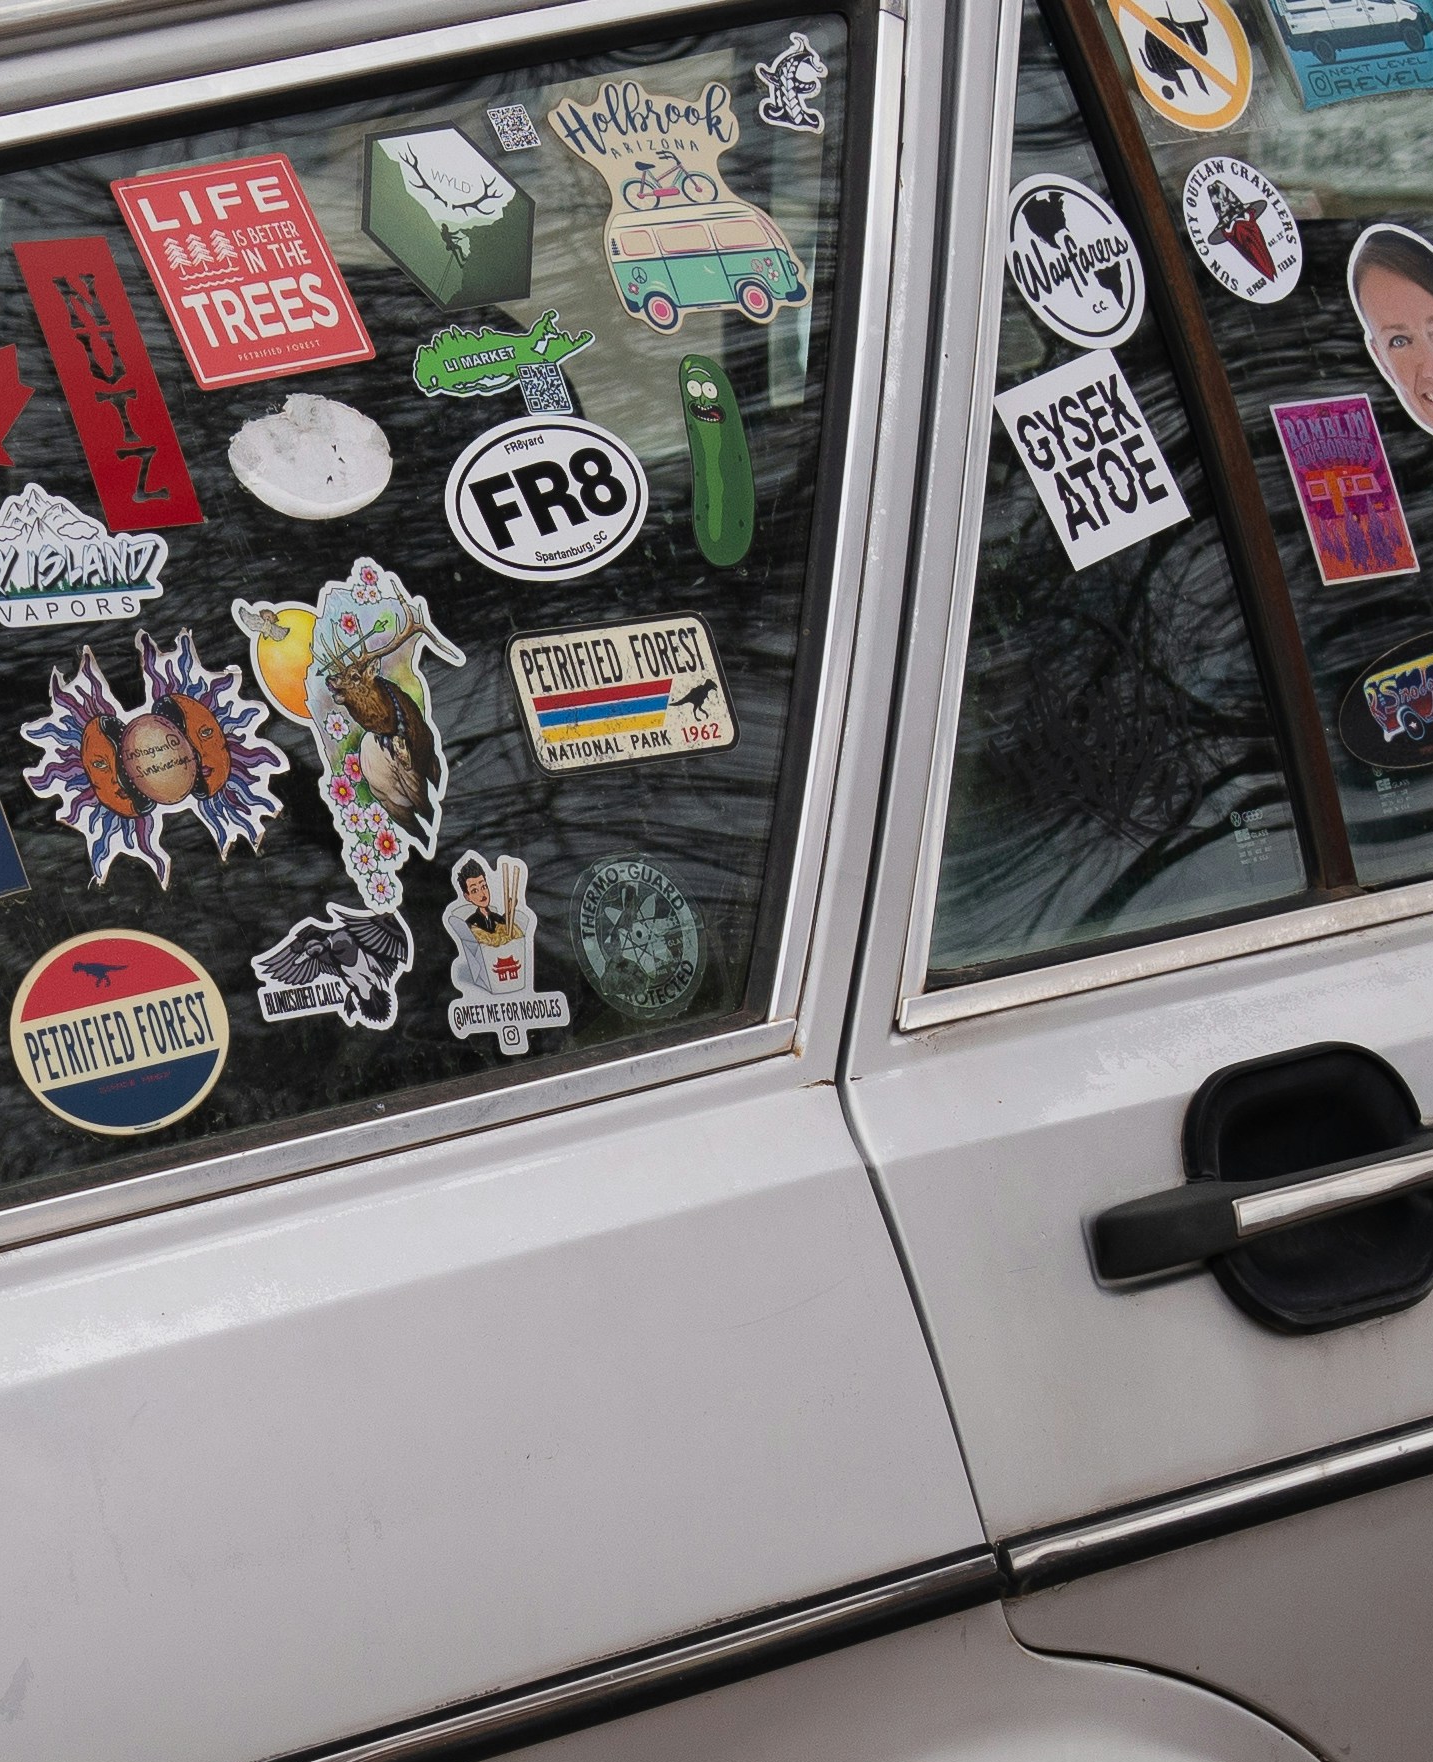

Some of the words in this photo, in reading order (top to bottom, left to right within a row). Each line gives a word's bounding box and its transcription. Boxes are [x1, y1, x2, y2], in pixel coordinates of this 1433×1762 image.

[556, 81, 735, 155] Holbrook
[610, 138, 700, 161] ARIZONA
[137, 175, 290, 232] LIFE
[431, 168, 471, 194] WYLD
[1185, 160, 1226, 208] OUTLAW
[1230, 161, 1297, 245] CRAWLERS
[231, 229, 248, 248] IS
[249, 220, 300, 246] BETTER
[241, 247, 267, 275] IN
[267, 239, 312, 270] THE
[1186, 213, 1210, 257] CITY
[1012, 234, 1129, 303] Wayfarers
[1209, 259, 1239, 292] SUN
[180, 272, 340, 349] TREES
[238, 347, 283, 362] PETRIFIED
[286, 338, 321, 355] FOREST
[444, 360, 460, 373] LI
[460, 345, 517, 370] MARKET
[52, 273, 171, 503] NUTZ
[503, 434, 545, 455] FR8yard
[1016, 373, 1142, 472] GYSEK
[468, 447, 629, 552] FR8
[1053, 433, 1170, 542] ATOE
[27, 538, 161, 591] ISLAND
[535, 540, 595, 564] Spartanburg,
[593, 530, 609, 545] SC
[519, 638, 624, 695] PETRIFIED
[628, 626, 706, 679] FOREST
[547, 737, 625, 763] NATIONAL
[630, 729, 672, 751] PARK
[681, 722, 722, 744] 1962
[581, 863, 685, 940] THERMO-GUARD
[263, 985, 317, 1016] BLINDSIDED
[315, 981, 345, 1007] CALLS
[453, 1006, 486, 1031] @MEET
[486, 1004, 502, 1023] ME
[501, 1003, 519, 1021] FOR
[519, 998, 562, 1020] NOODLES
[23, 1010, 135, 1084] PETRIFIED
[133, 991, 214, 1058] FOREST
